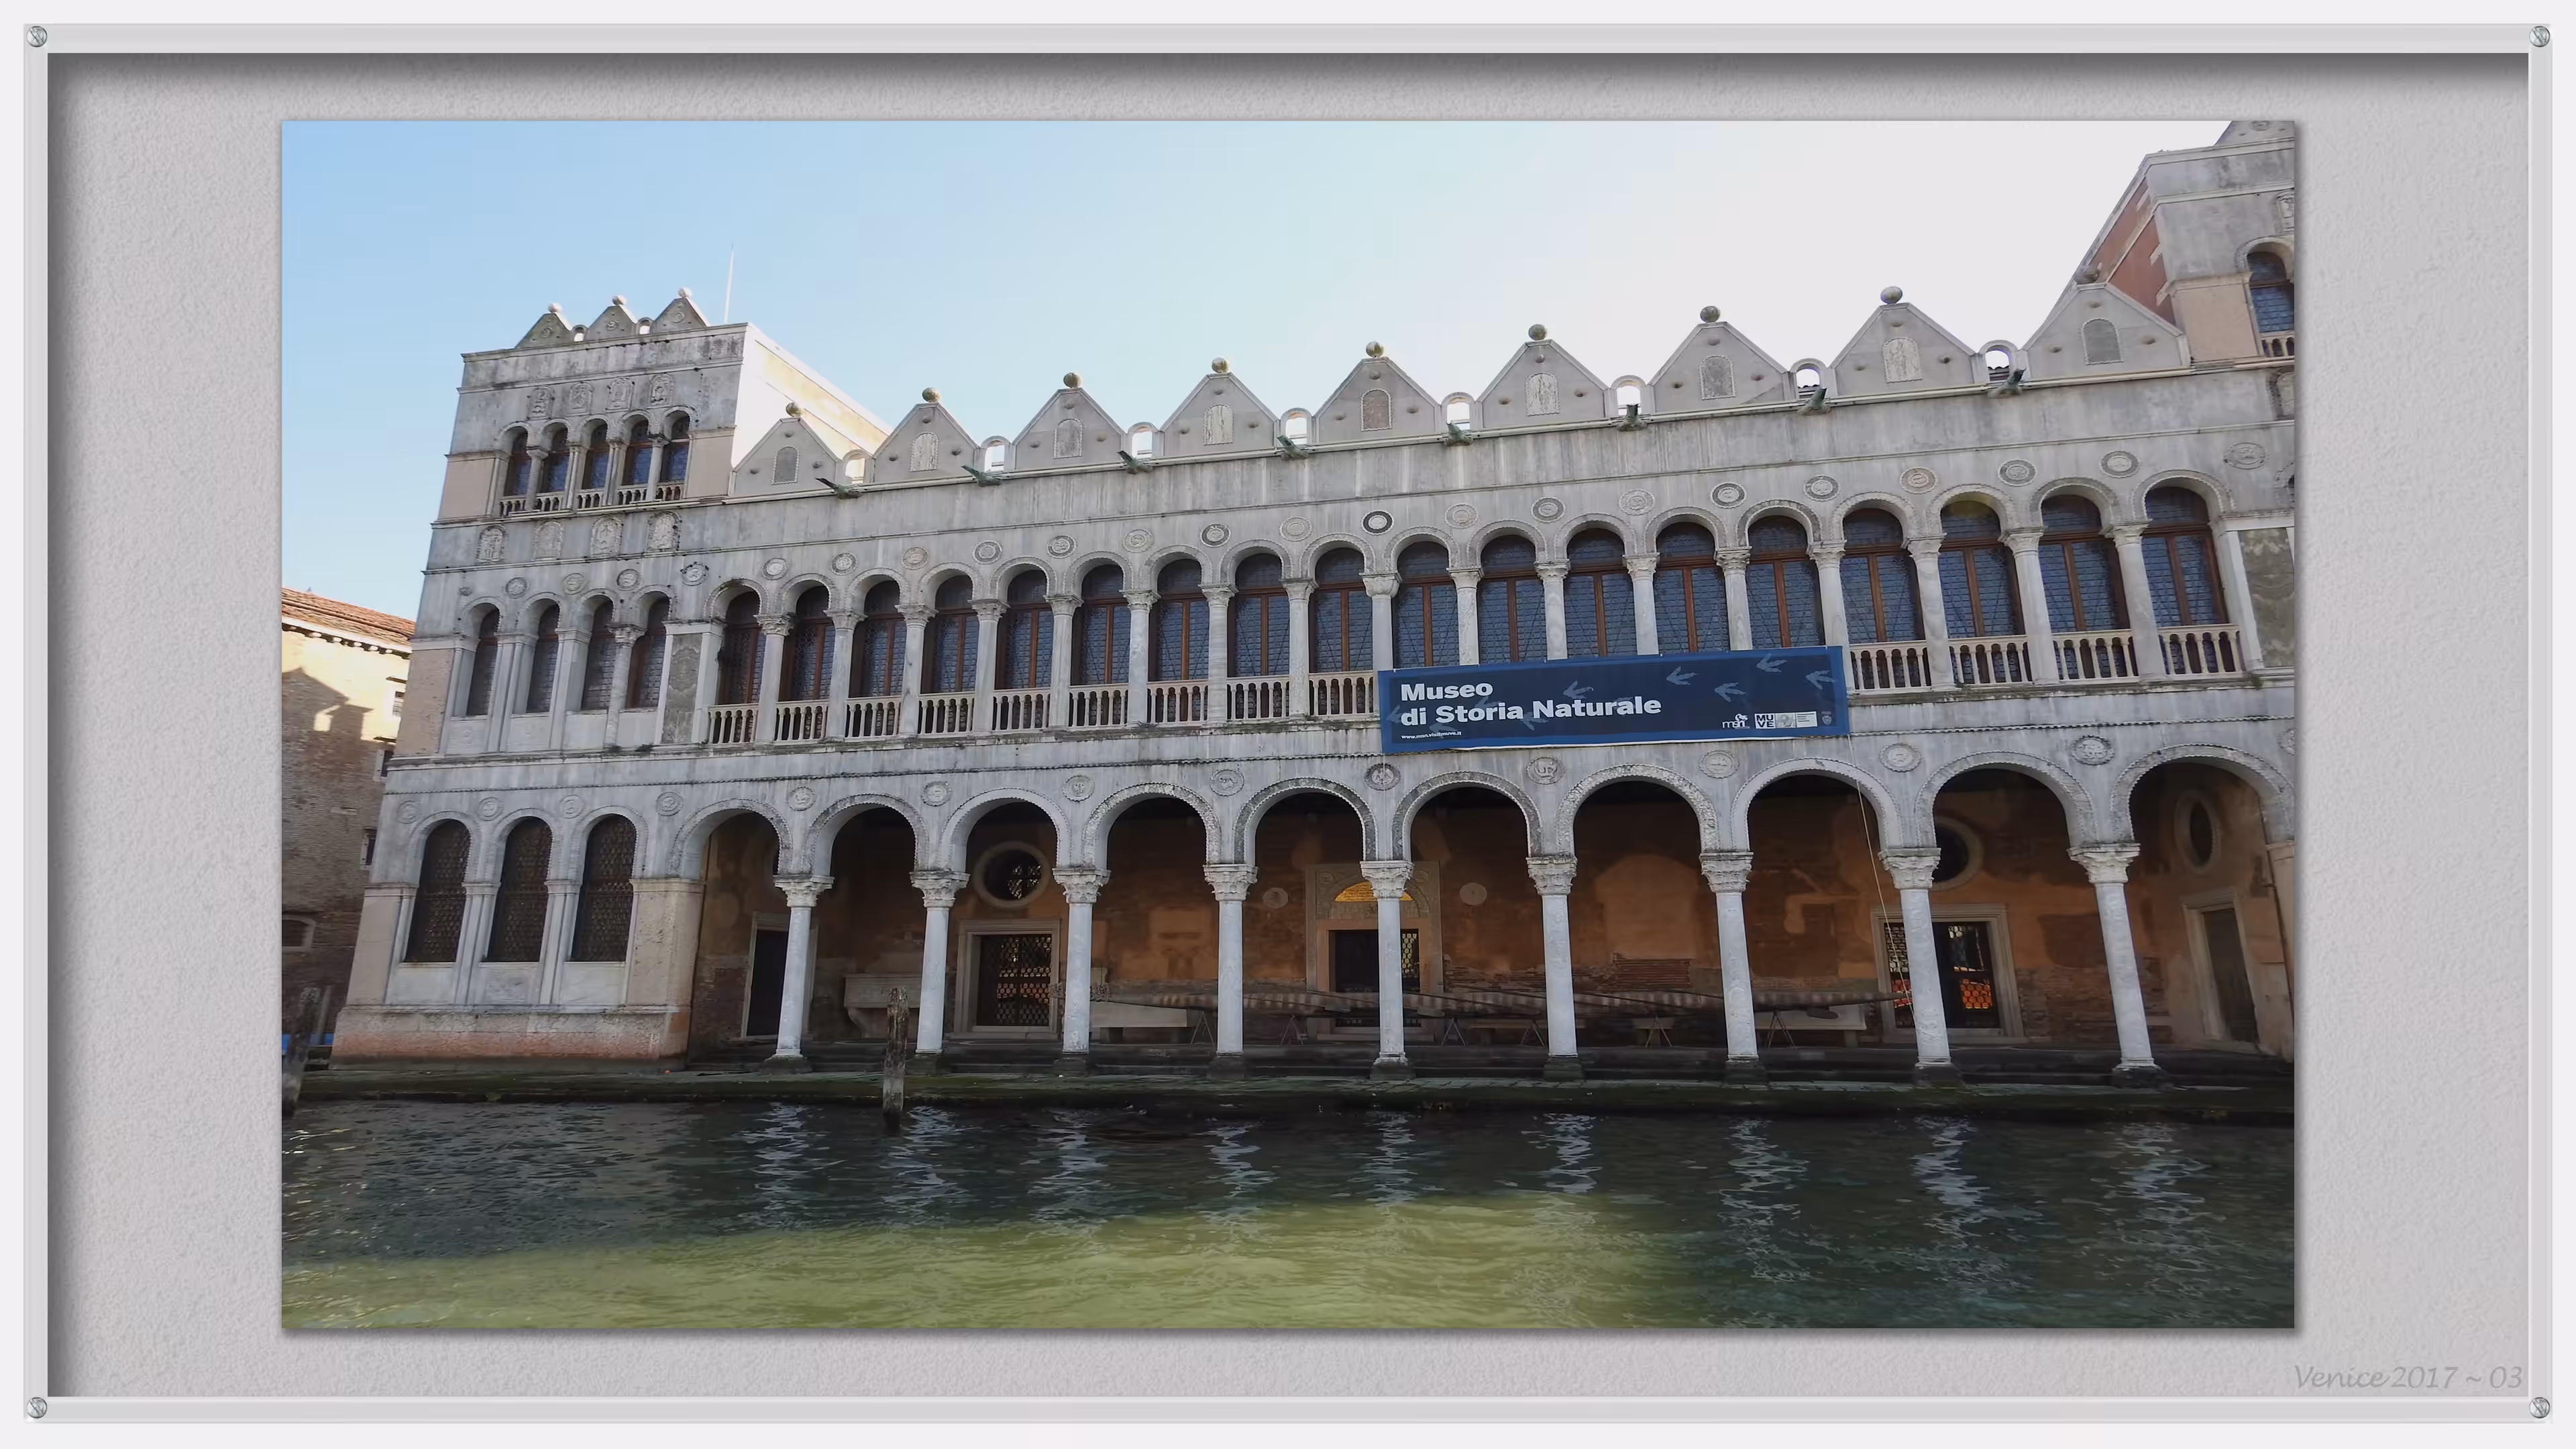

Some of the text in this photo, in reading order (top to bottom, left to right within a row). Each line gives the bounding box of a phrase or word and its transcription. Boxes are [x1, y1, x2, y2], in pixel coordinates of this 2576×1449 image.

[1401, 683, 1493, 701] Museo
[1401, 696, 1662, 726] di Storia Naturale
[1401, 731, 1462, 739] www.msn.visitmuve.it
